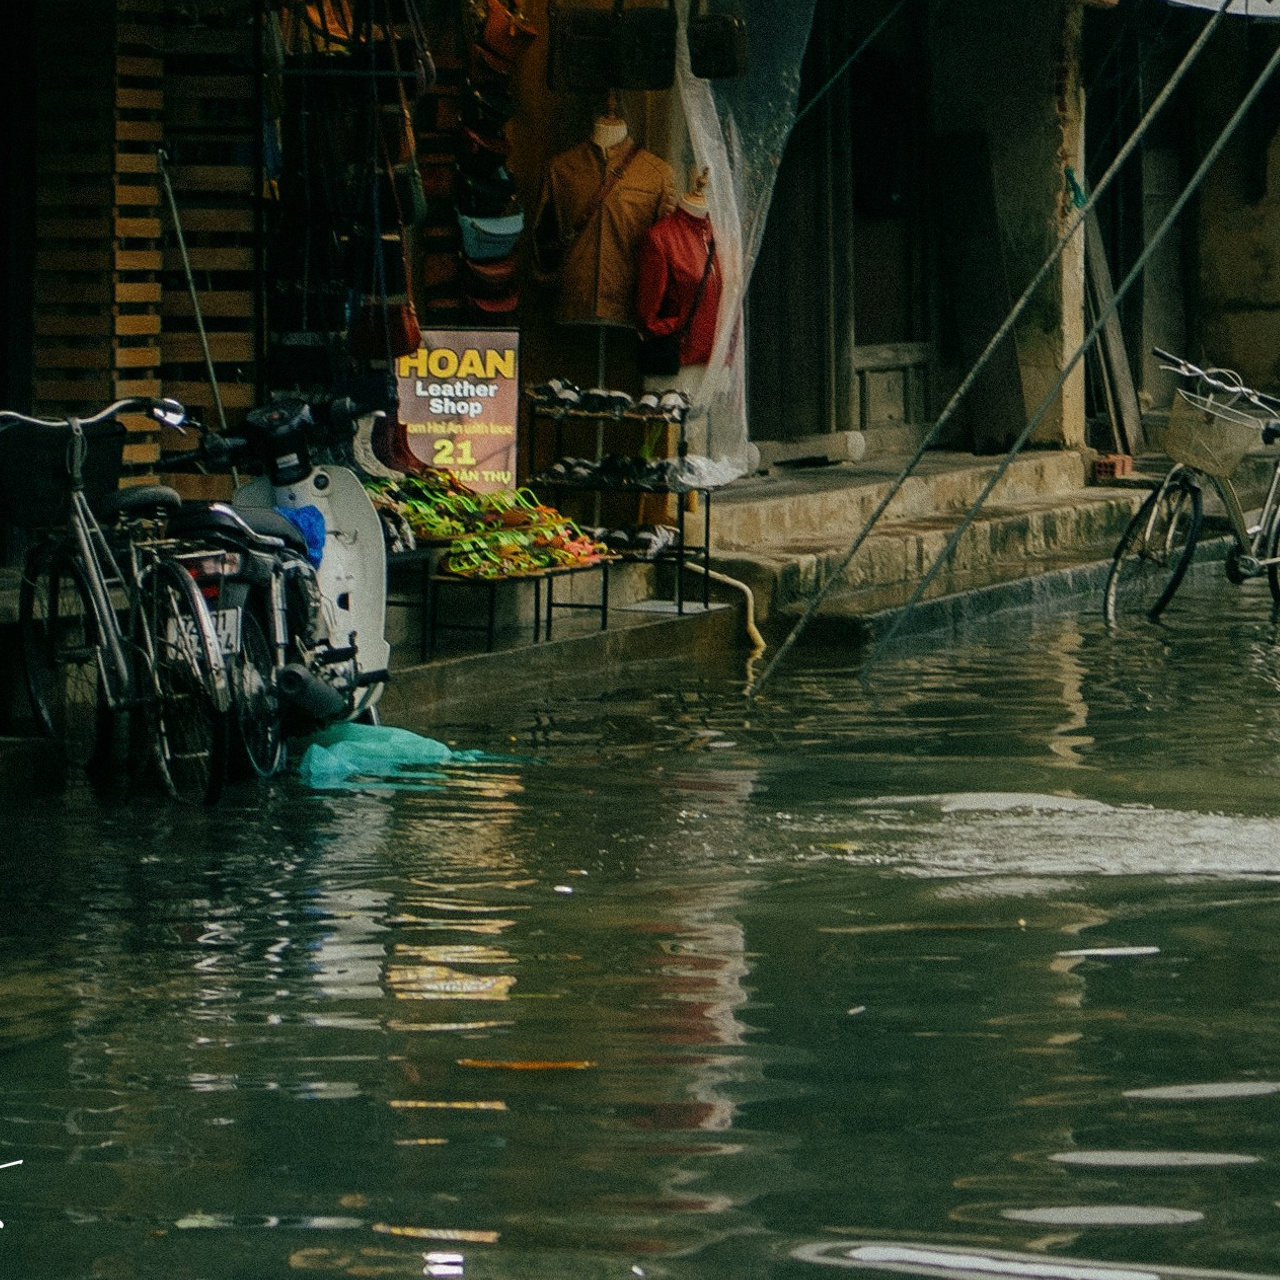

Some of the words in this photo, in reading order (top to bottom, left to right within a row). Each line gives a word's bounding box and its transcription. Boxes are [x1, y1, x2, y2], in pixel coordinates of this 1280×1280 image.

[399, 348, 515, 378] HOAN
[416, 381, 498, 397] Leather
[429, 398, 483, 418] Shop
[432, 438, 477, 465] 21
